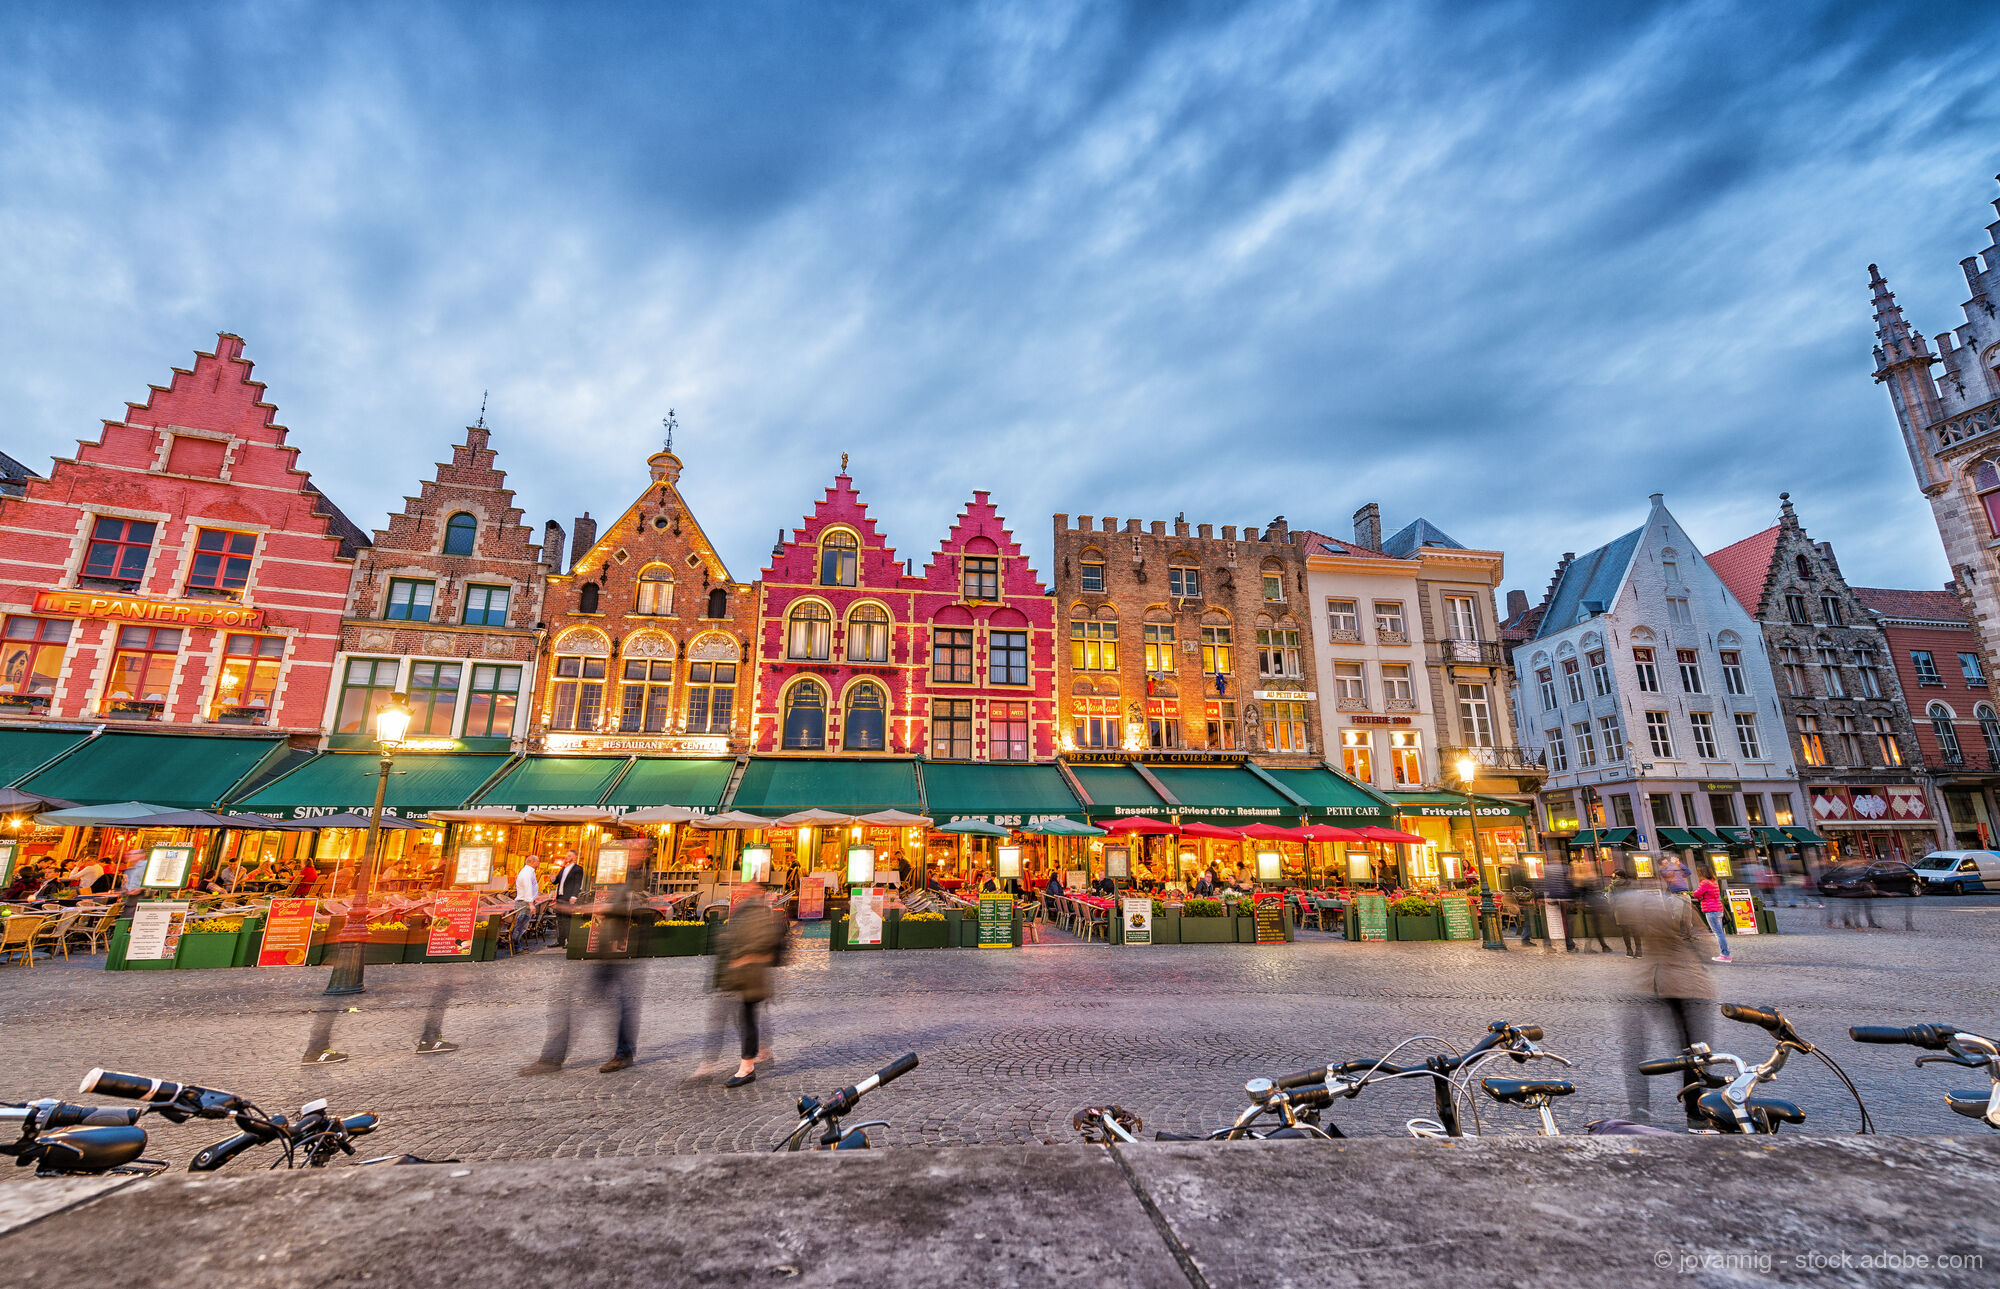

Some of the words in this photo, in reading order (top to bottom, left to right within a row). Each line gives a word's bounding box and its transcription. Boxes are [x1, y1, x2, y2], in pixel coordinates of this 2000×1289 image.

[44, 598, 81, 614] LE
[88, 599, 191, 622] PANIER
[197, 609, 258, 627] D'OR
[1351, 715, 1391, 724] FRITERIE
[1392, 716, 1412, 725] 1900
[603, 740, 662, 750] RESTAURANT
[681, 740, 725, 750] CENTRA
[1069, 753, 1144, 762] RESTAURANT
[1150, 753, 1165, 762] LA
[1170, 753, 1214, 762] CIVIERE
[1220, 754, 1246, 763] D'OR
[228, 810, 284, 819] Resurant
[292, 806, 338, 820] SINT
[1114, 806, 1159, 815] Brasserie
[1166, 806, 1177, 815] La
[1210, 807, 1230, 816] d'Or
[1237, 807, 1281, 816] Restaurant
[1326, 806, 1353, 816] PETIT
[1355, 806, 1380, 816] CAFE
[1421, 807, 1471, 816] Friterie
[1475, 807, 1511, 816] 1900
[994, 815, 1022, 827] DES
[1028, 815, 1067, 827] ART
